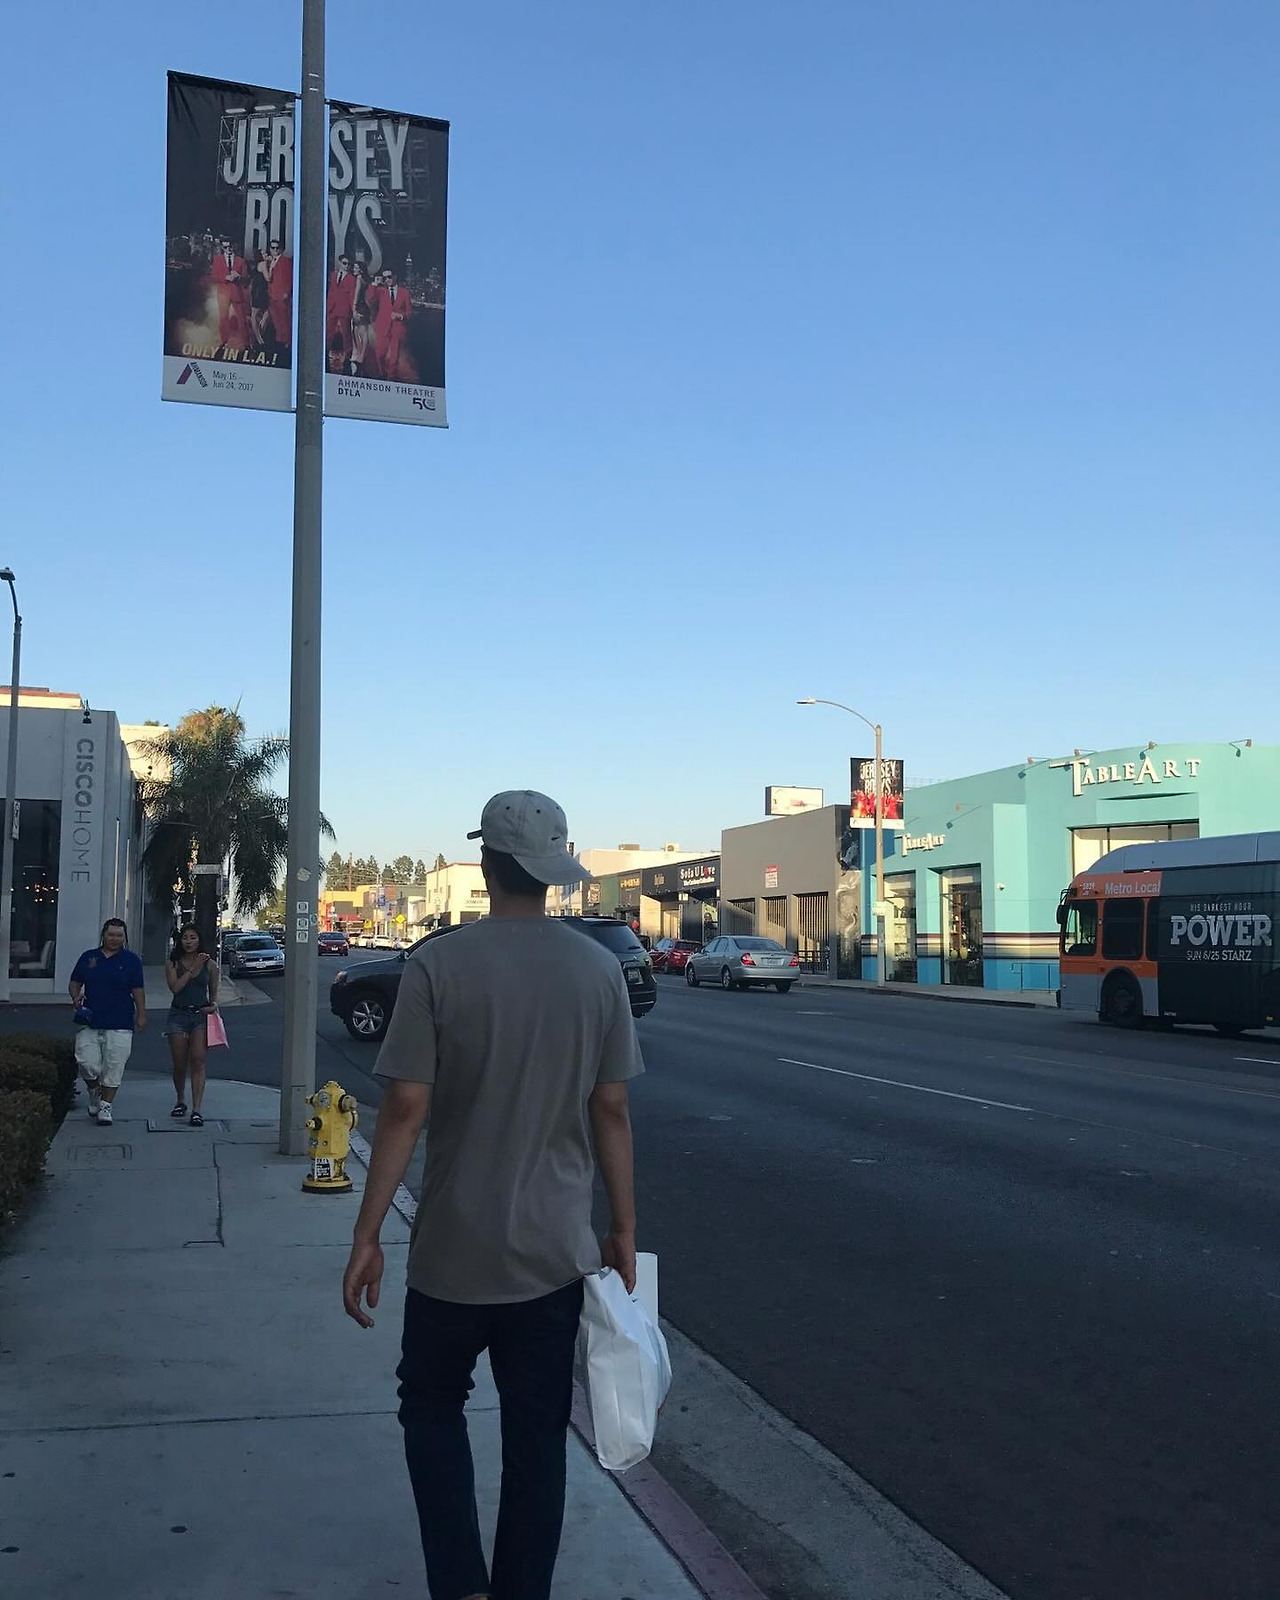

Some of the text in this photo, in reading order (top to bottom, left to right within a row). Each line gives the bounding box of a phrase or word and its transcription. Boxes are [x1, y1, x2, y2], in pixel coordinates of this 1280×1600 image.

[182, 343, 277, 365] ONLY IN L.A.!
[212, 370, 227, 381] May
[212, 380, 224, 389] Jun
[238, 383, 254, 391] 2017
[338, 379, 436, 398] AHMANSON THEATRE
[338, 387, 361, 397] DTLA
[1105, 881, 1161, 895] Metro Local
[1170, 914, 1273, 946] POWER
[1186, 949, 1252, 961] SUN 6/25 STARZ
